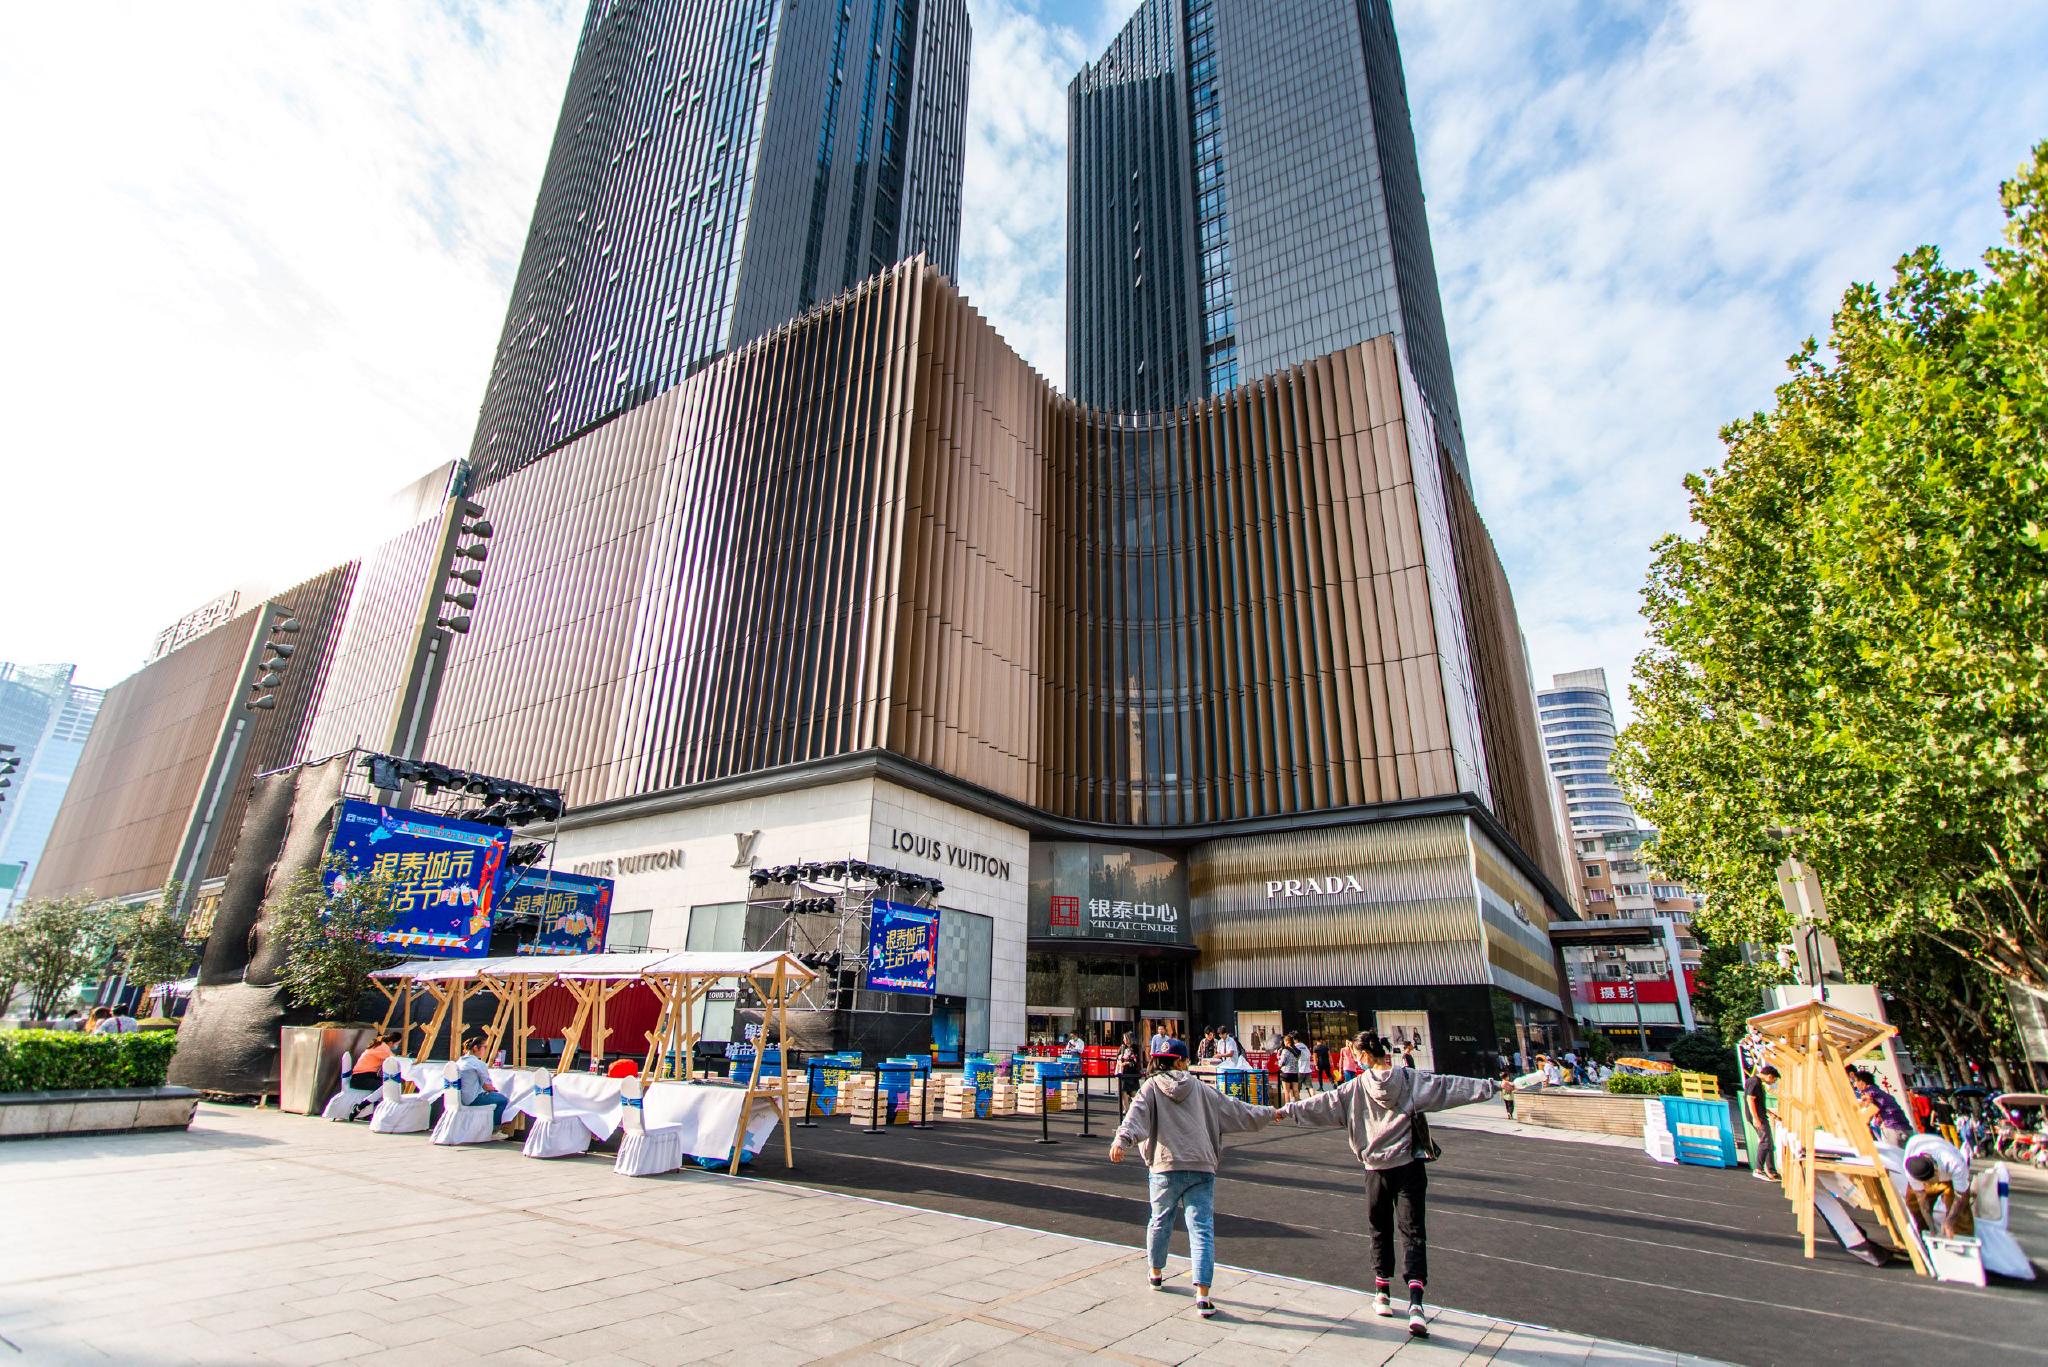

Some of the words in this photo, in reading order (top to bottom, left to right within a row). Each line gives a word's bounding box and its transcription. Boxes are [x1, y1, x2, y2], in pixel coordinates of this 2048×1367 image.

[617, 848, 683, 875] VUITTON
[892, 829, 941, 861] LOUIS
[947, 844, 1010, 881] VUITTON
[1265, 875, 1365, 899] PRADA
[1088, 897, 1178, 923] 银泰中心
[1089, 919, 1131, 930] YINTAI
[1132, 922, 1178, 934] CENTRE
[1305, 999, 1345, 1009] PRADA
[1449, 1034, 1478, 1042] PRADA
